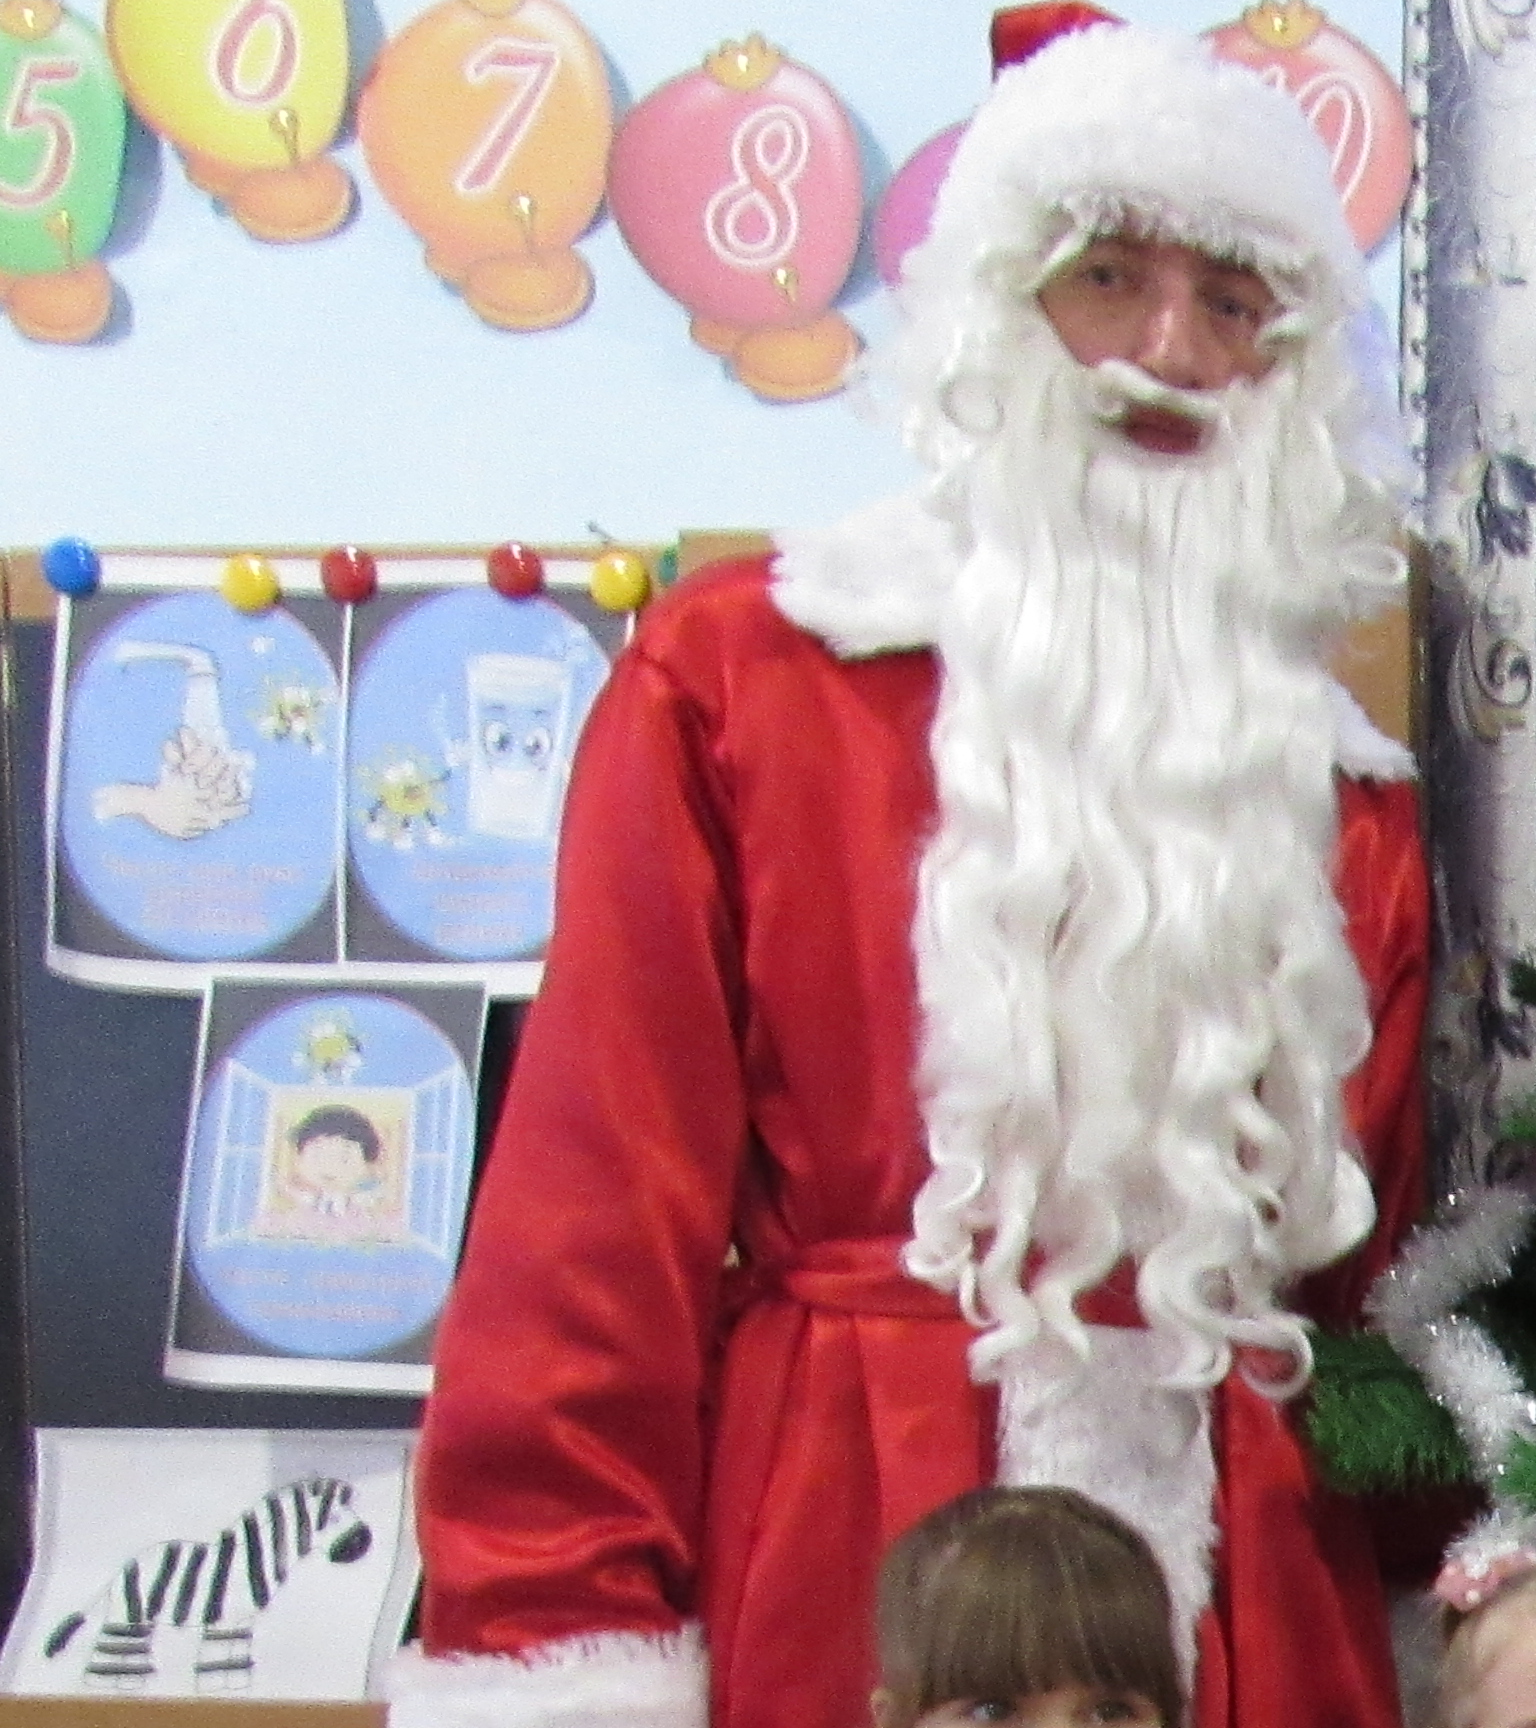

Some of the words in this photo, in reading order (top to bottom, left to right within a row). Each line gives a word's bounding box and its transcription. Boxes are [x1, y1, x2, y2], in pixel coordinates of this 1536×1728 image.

[0, 55, 80, 207] 5
[453, 37, 564, 196] 7
[702, 103, 811, 270] 8
